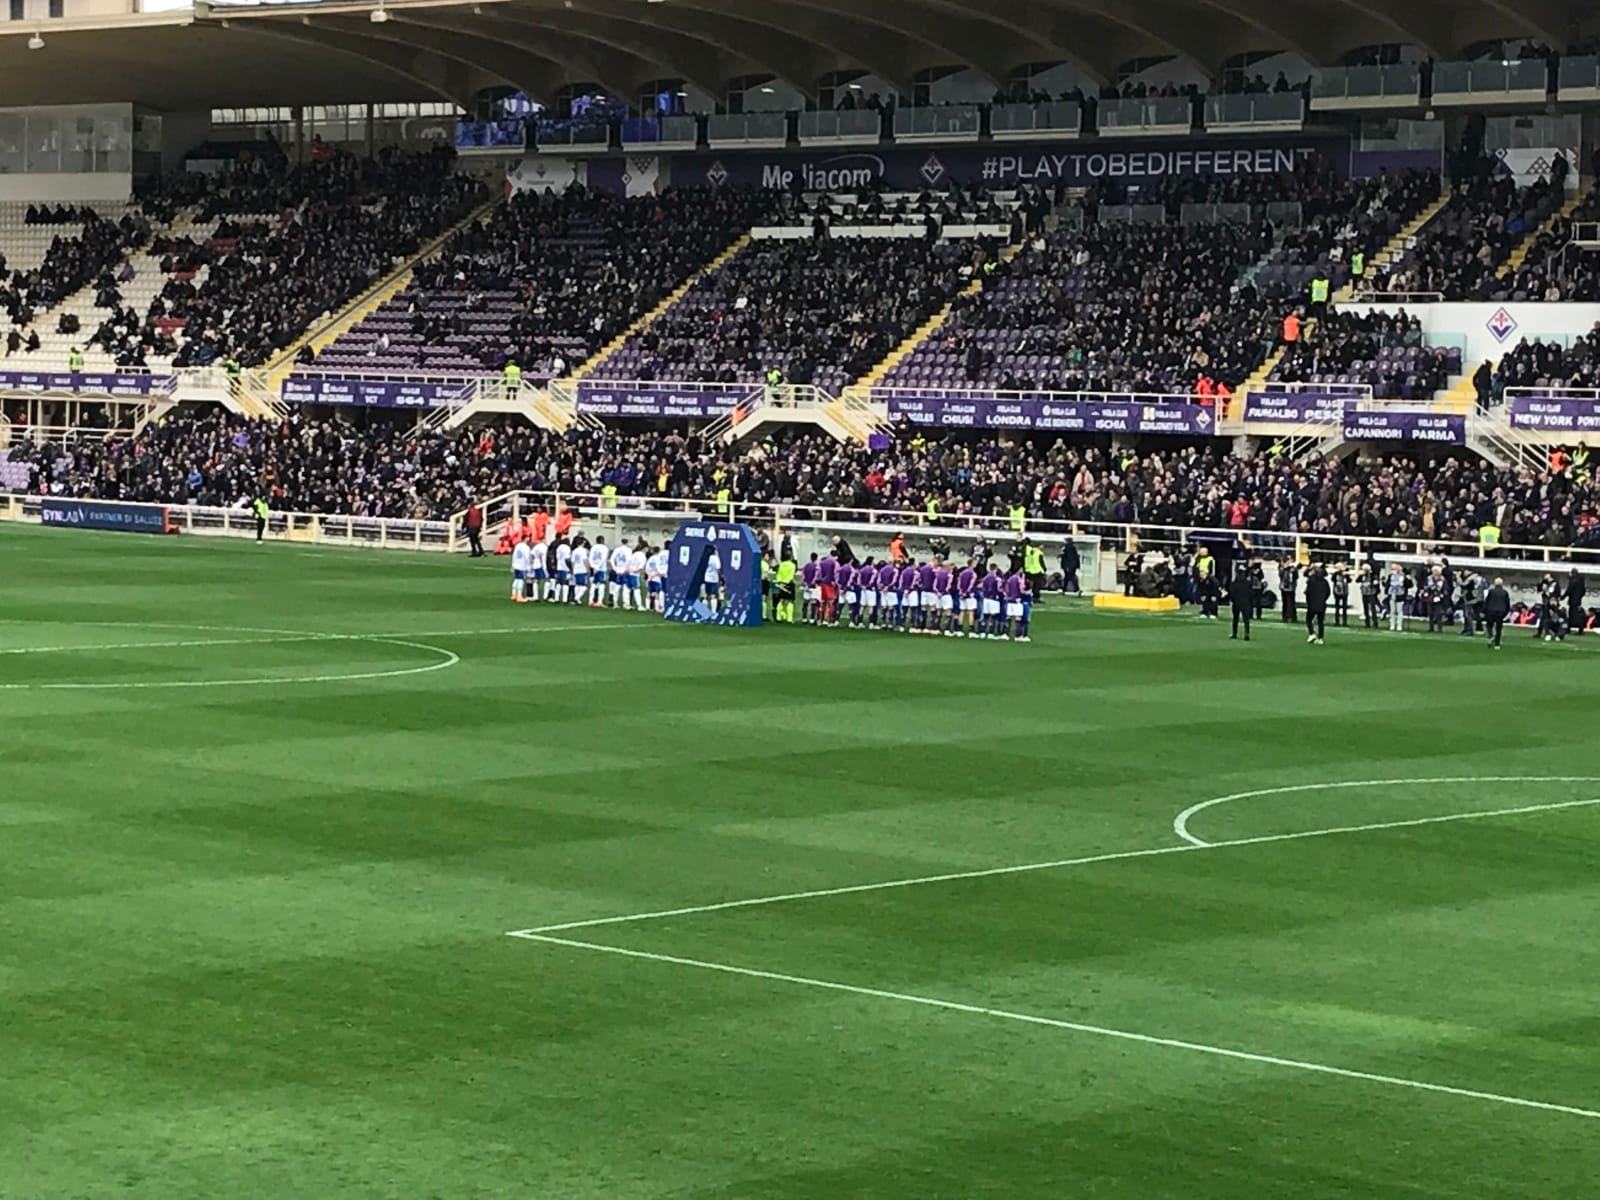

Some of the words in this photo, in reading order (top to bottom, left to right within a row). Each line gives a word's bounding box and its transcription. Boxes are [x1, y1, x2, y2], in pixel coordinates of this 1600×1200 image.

[762, 163, 871, 190] Meiacom
[986, 415, 1031, 425] LONDRA
[1304, 409, 1344, 420] PESC
[1515, 414, 1541, 424] NEW
[1544, 415, 1573, 426] YORK
[1344, 427, 1402, 439] CAPANNORI
[1412, 429, 1456, 441] PARMA
